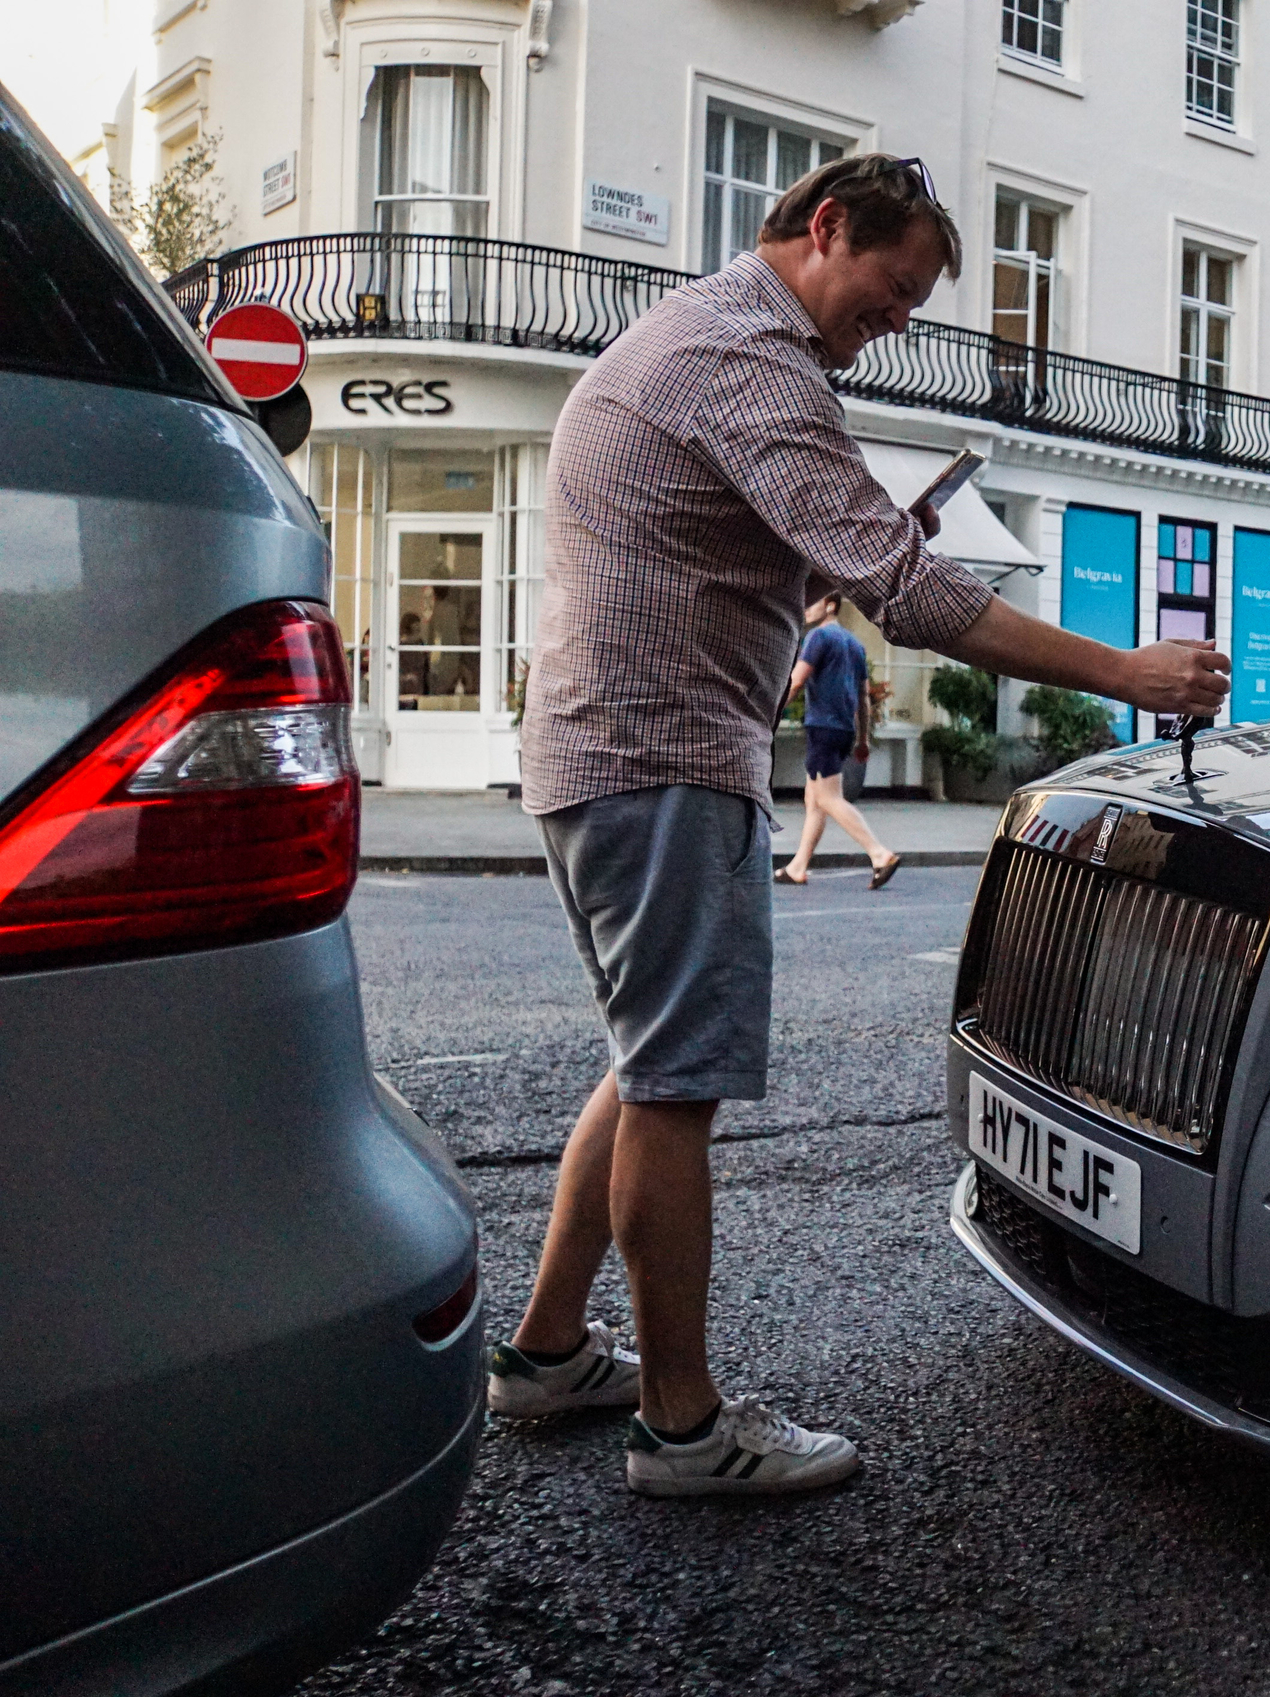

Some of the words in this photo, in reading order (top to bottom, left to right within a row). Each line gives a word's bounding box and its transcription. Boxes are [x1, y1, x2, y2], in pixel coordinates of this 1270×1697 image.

[592, 183, 644, 208] LOWNDES
[592, 199, 631, 219] STREET
[636, 209, 658, 226] SW1
[340, 379, 454, 416] ERES
[1073, 566, 1123, 583] Belgravia
